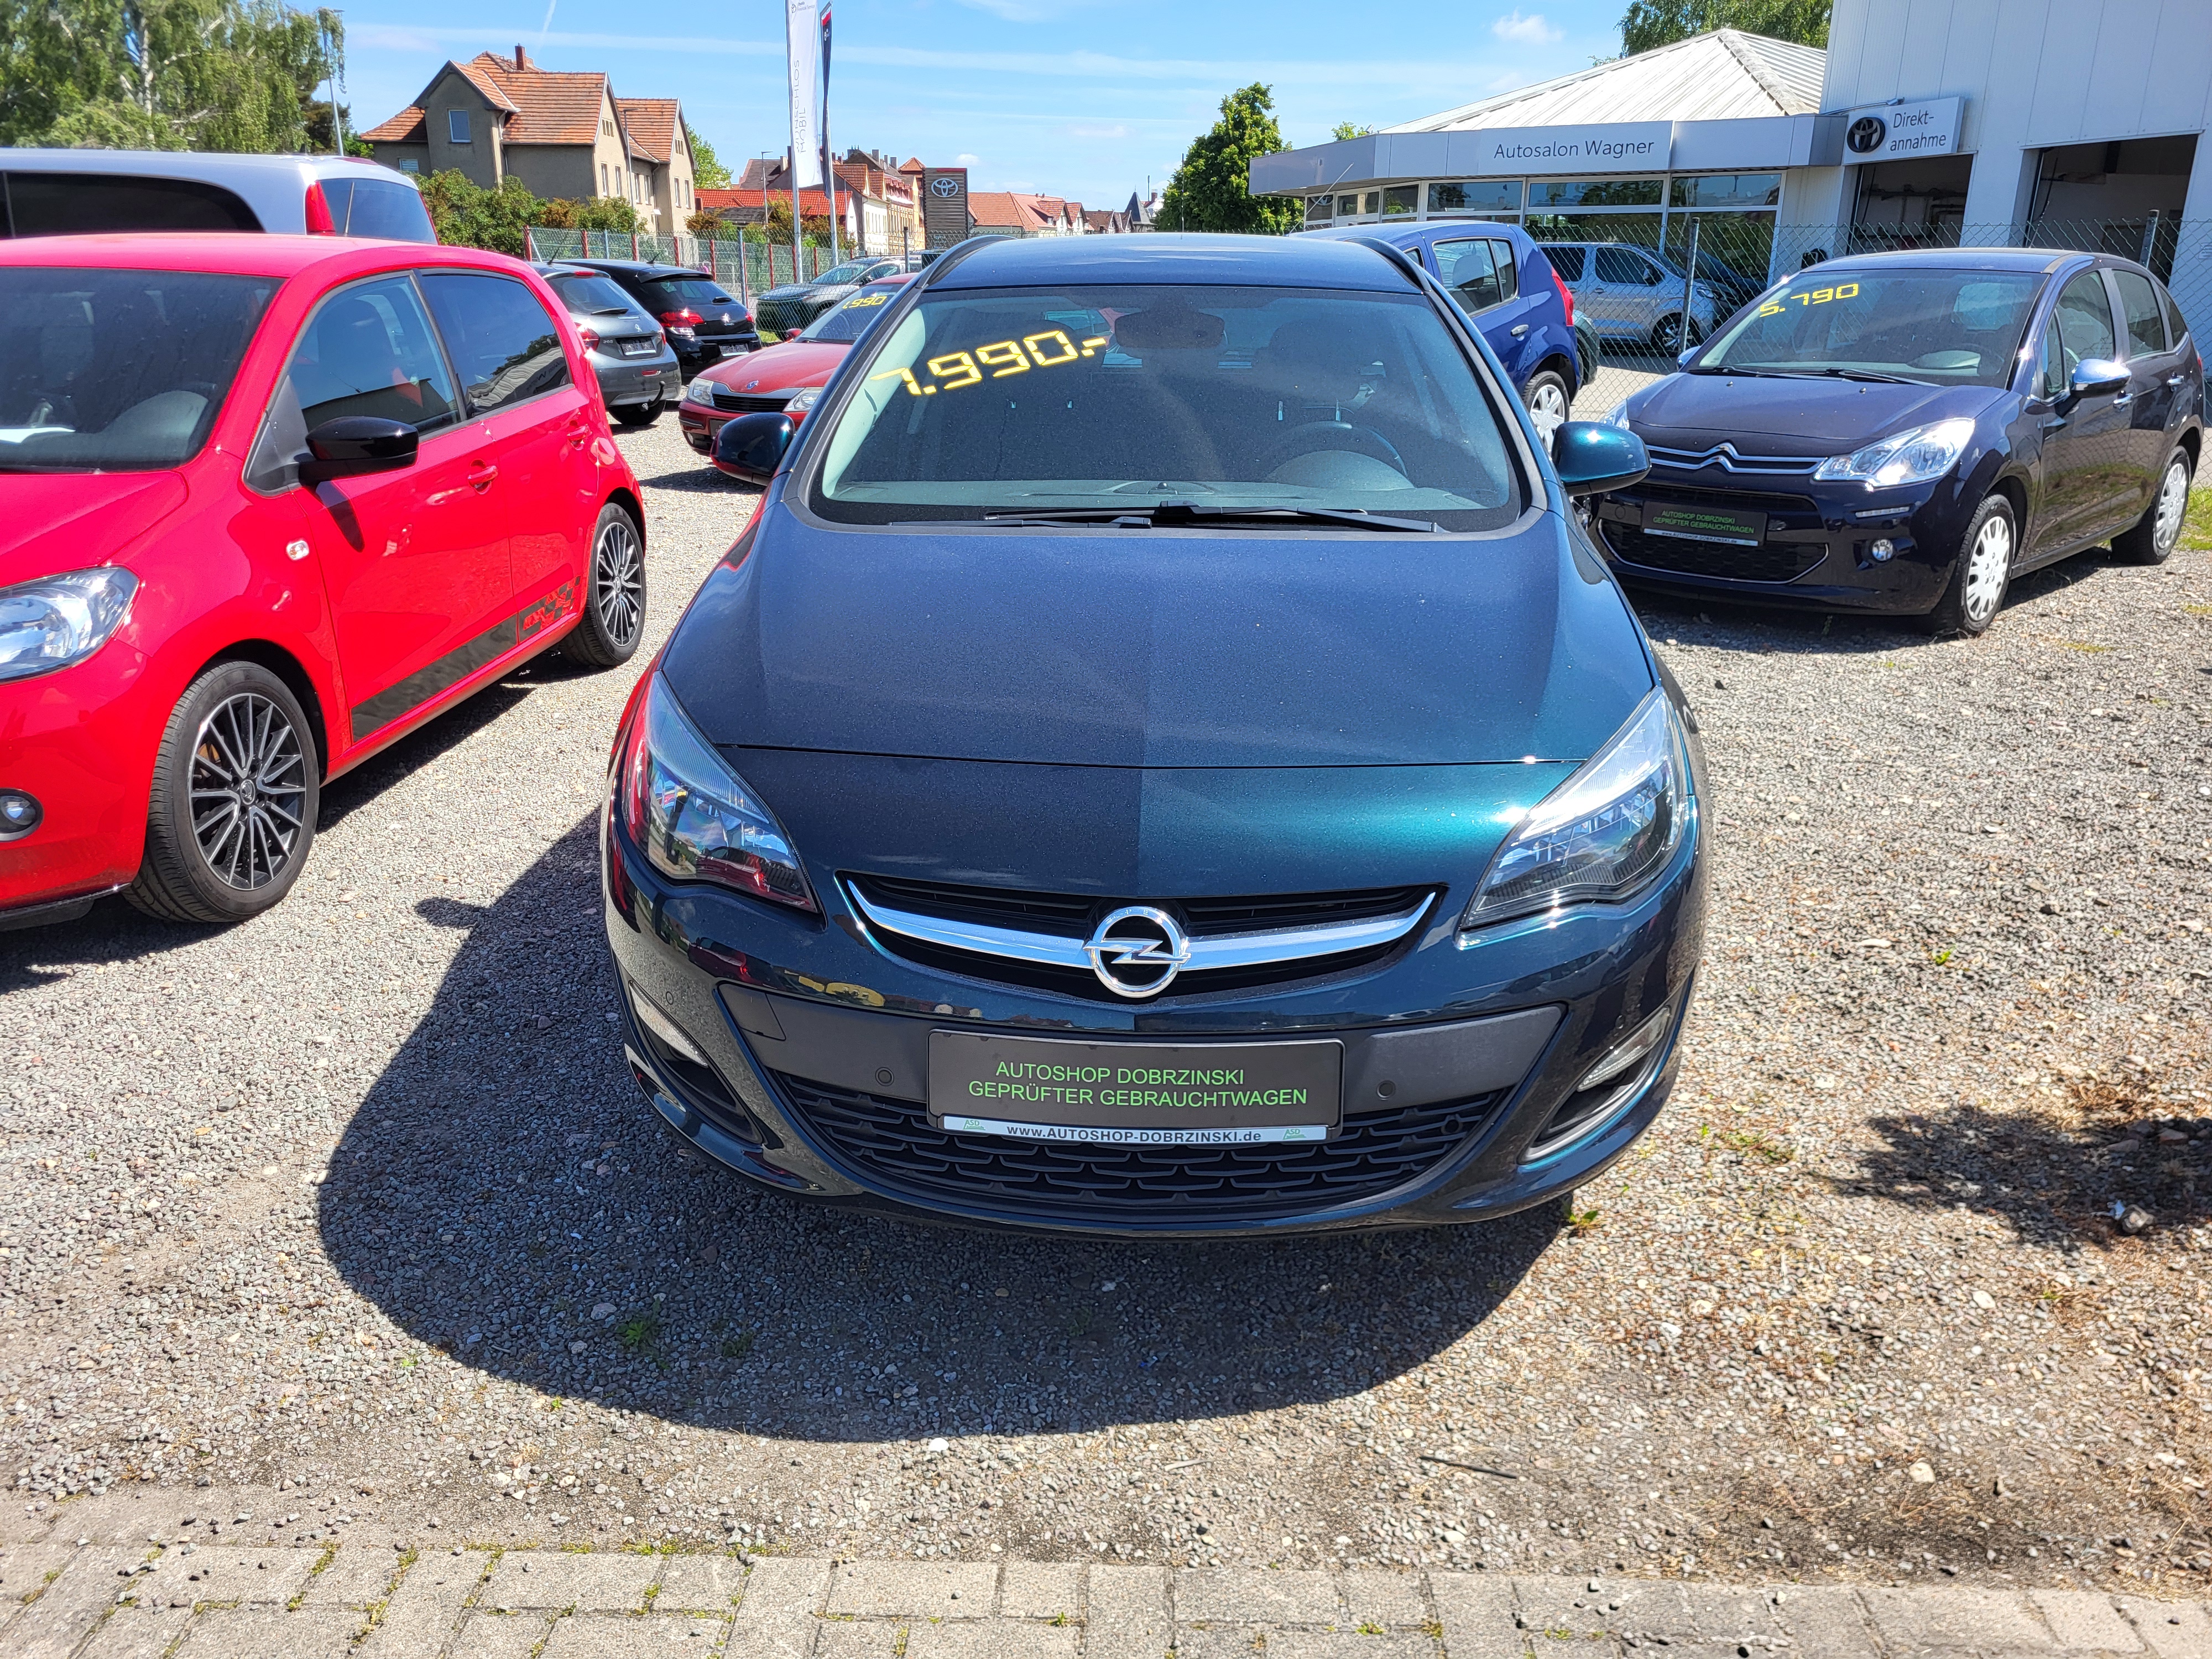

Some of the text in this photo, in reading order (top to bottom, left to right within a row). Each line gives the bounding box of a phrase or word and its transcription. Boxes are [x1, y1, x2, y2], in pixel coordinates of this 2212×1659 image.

[1893, 109, 1934, 128] Direkt-
[1494, 139, 1655, 159] Autosalon Wagner
[1890, 132, 1947, 152] annahme
[1661, 510, 1735, 524] AUTOSHOP DOBRZINSKI
[1690, 520, 1755, 534] GEBRAUCHTWAGEN
[995, 1061, 1244, 1086] AUTOSHOP DOBRZINSKI
[968, 1081, 1307, 1107] GEPRÜFTER GEBRAUCHTWAGEN
[1006, 1126, 1262, 1143] www.AUTOSHOP-DOBRZINSKI.de
